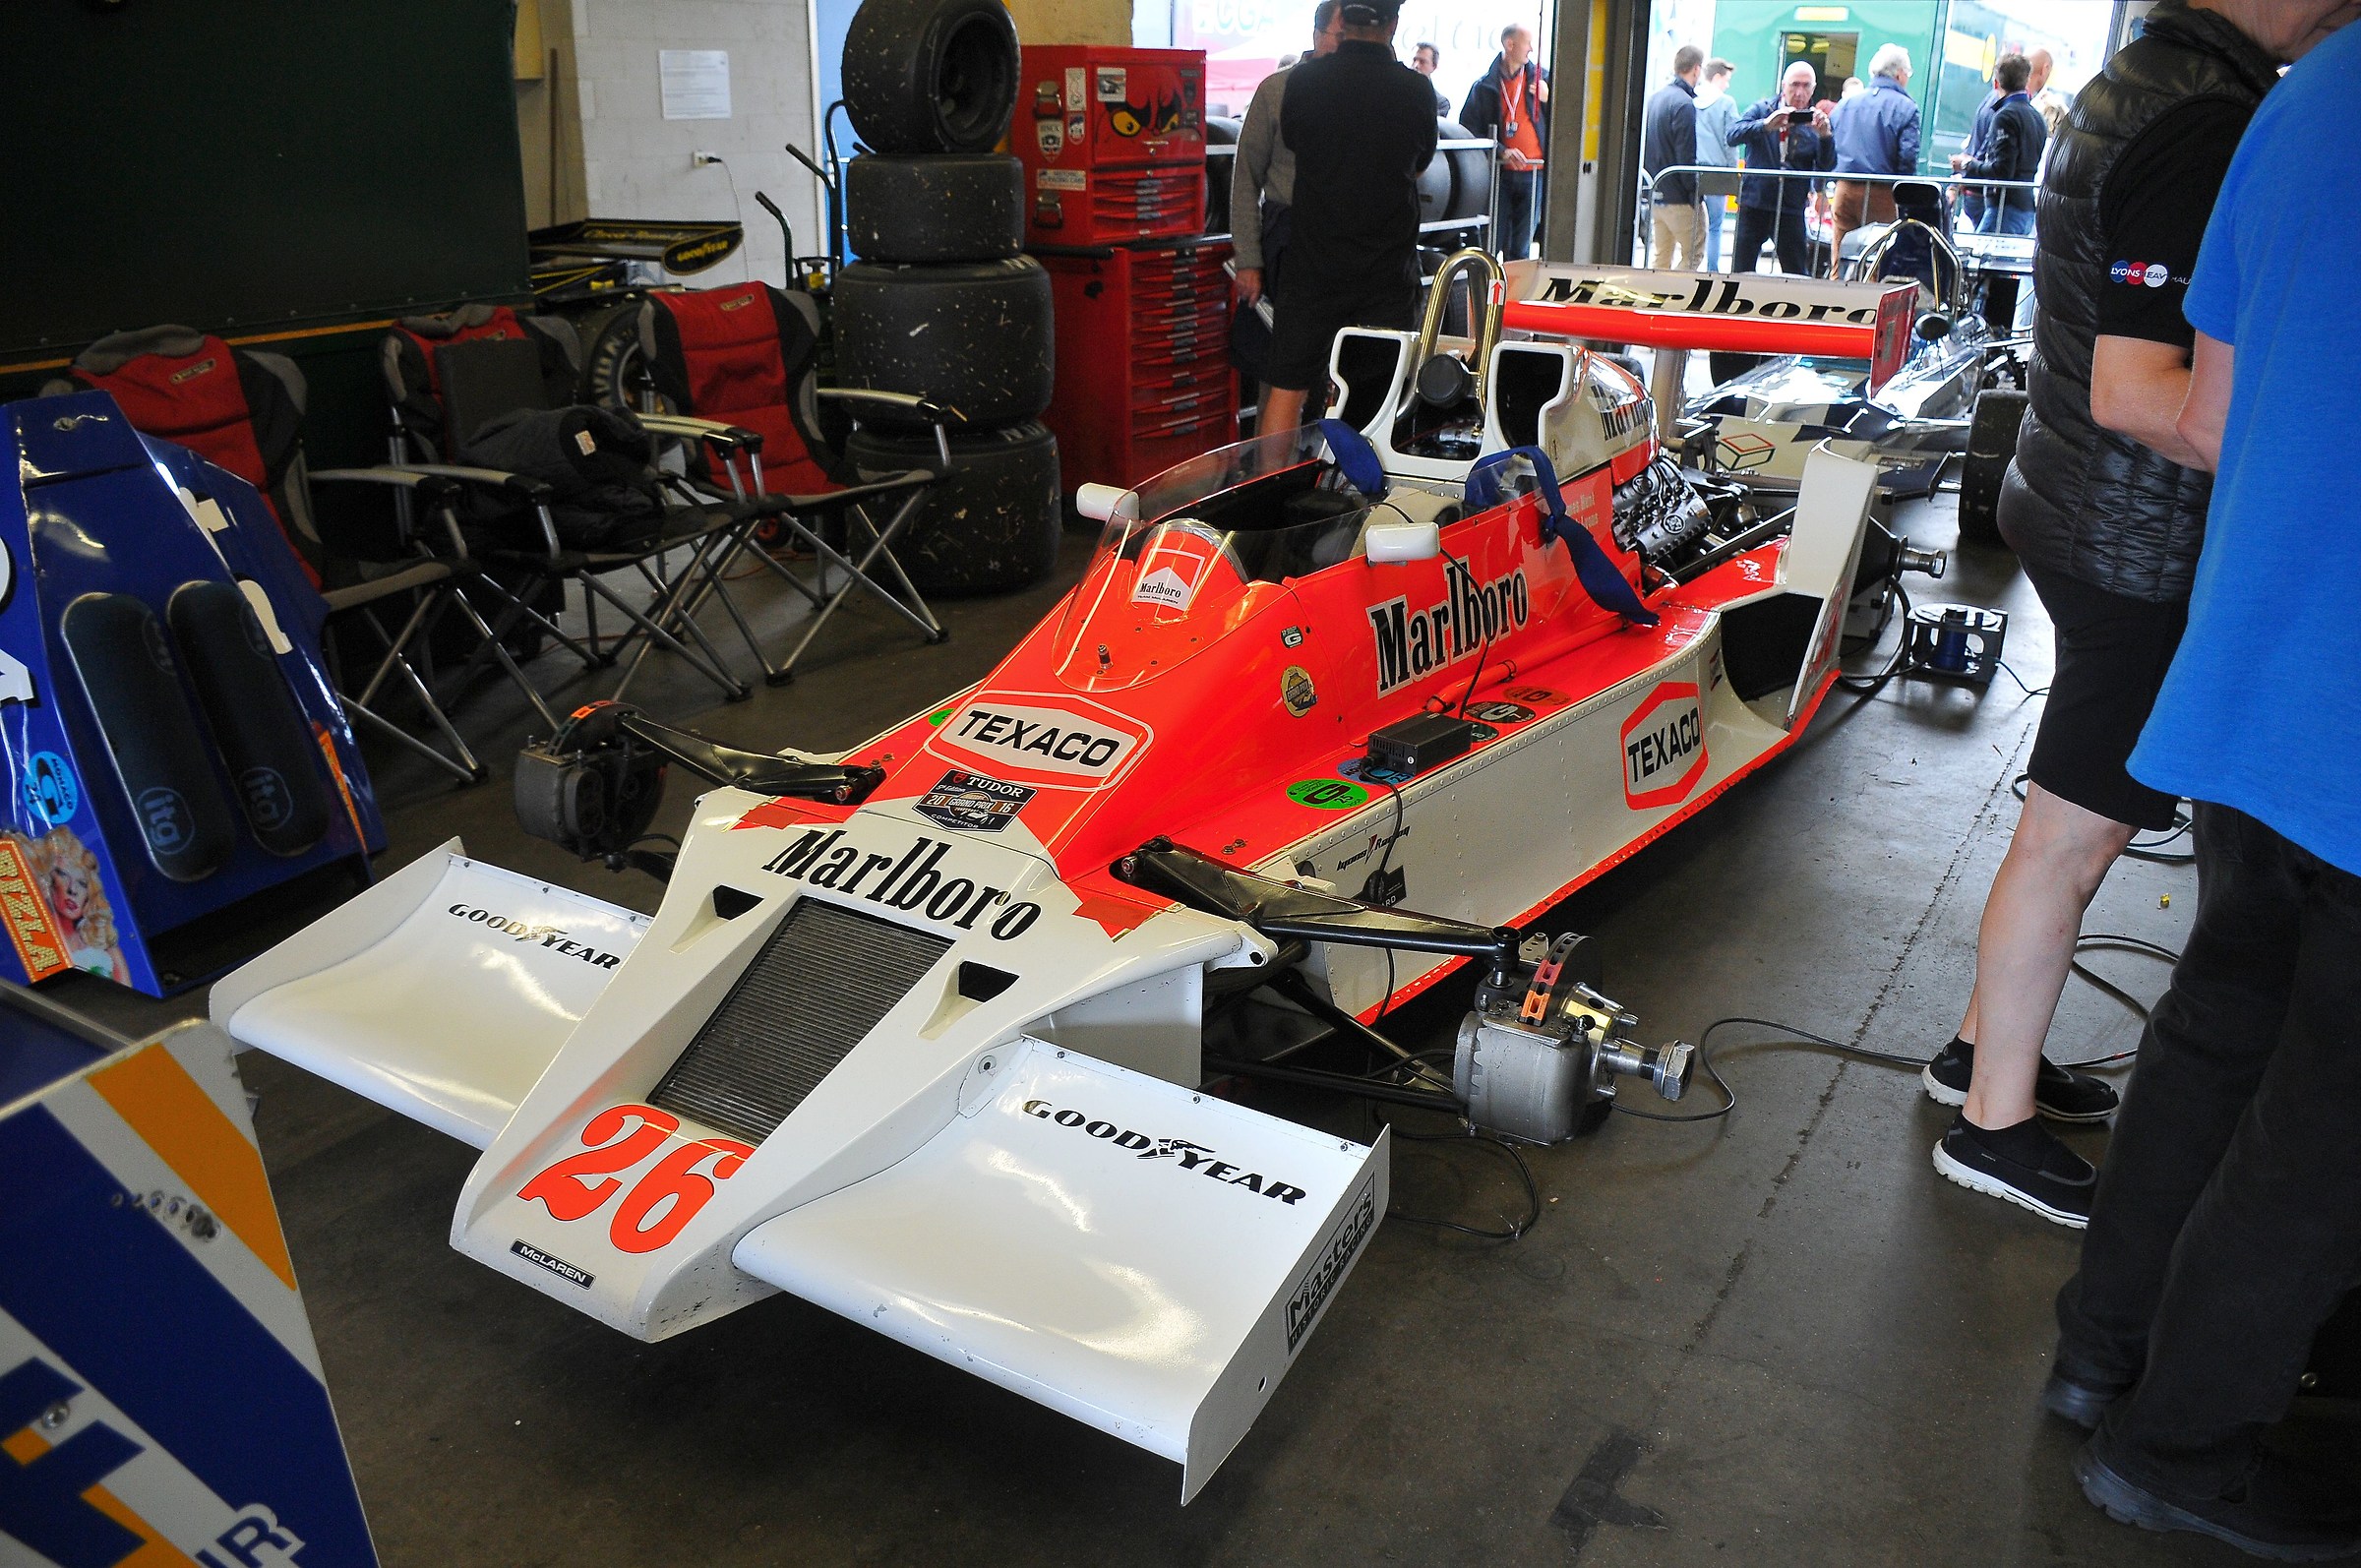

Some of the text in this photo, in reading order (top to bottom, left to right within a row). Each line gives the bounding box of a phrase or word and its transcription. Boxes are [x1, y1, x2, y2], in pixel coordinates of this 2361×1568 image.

[2110, 268, 2141, 278] LYONS
[1540, 277, 1877, 327] Marlboro
[1139, 581, 1181, 599] Marlboro
[1369, 559, 1527, 693] Marlboro
[957, 709, 1120, 767] TEXACO
[1627, 706, 1701, 783] TEXACO
[926, 795, 944, 806] 20
[948, 797, 994, 811] GRAND PRIX
[967, 775, 1024, 798] TUDOR
[998, 802, 1015, 814] 16
[144, 793, 181, 846] itg
[931, 814, 980, 828] COMPETITOR
[761, 829, 1042, 941] Marlboro
[516, 1104, 756, 1254] 26
[519, 1244, 587, 1284] McLAREN
[1290, 1191, 1373, 1328] Masters
[1291, 1216, 1373, 1345] HISTORIC RACING
